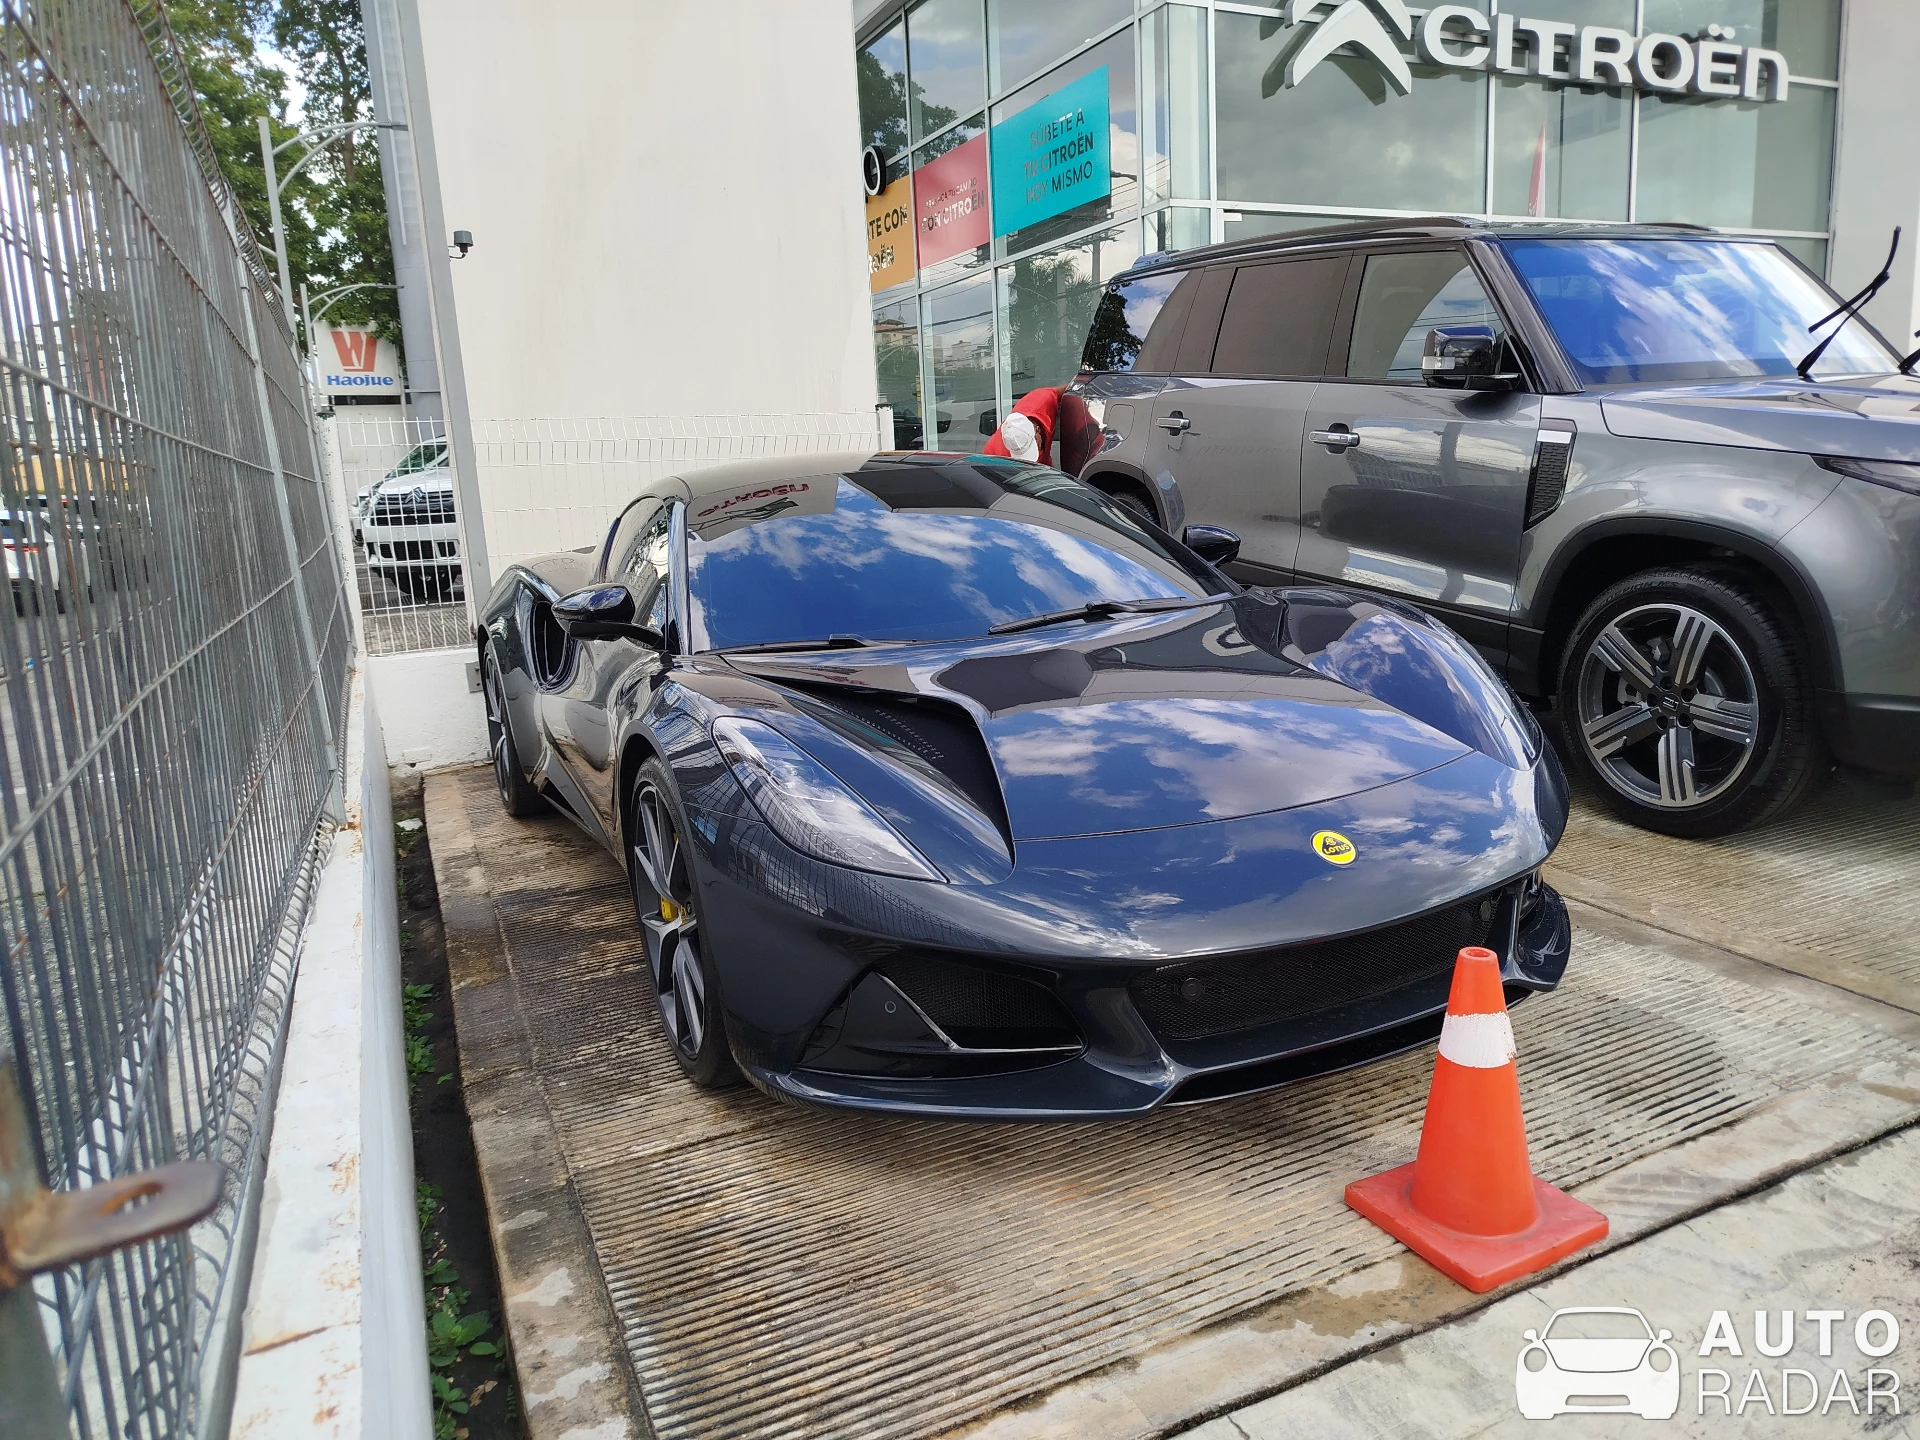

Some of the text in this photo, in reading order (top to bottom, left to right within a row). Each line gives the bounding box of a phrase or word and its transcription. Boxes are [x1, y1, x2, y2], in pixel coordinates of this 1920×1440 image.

[1076, 107, 1085, 127] A
[1024, 131, 1094, 181] TU CITROËN
[1026, 160, 1093, 205] HOY MISMO
[868, 203, 908, 241] TE CON
[943, 189, 985, 225] CITROËN
[326, 375, 395, 387] Haojue
[1323, 843, 1350, 854] LOTUS
